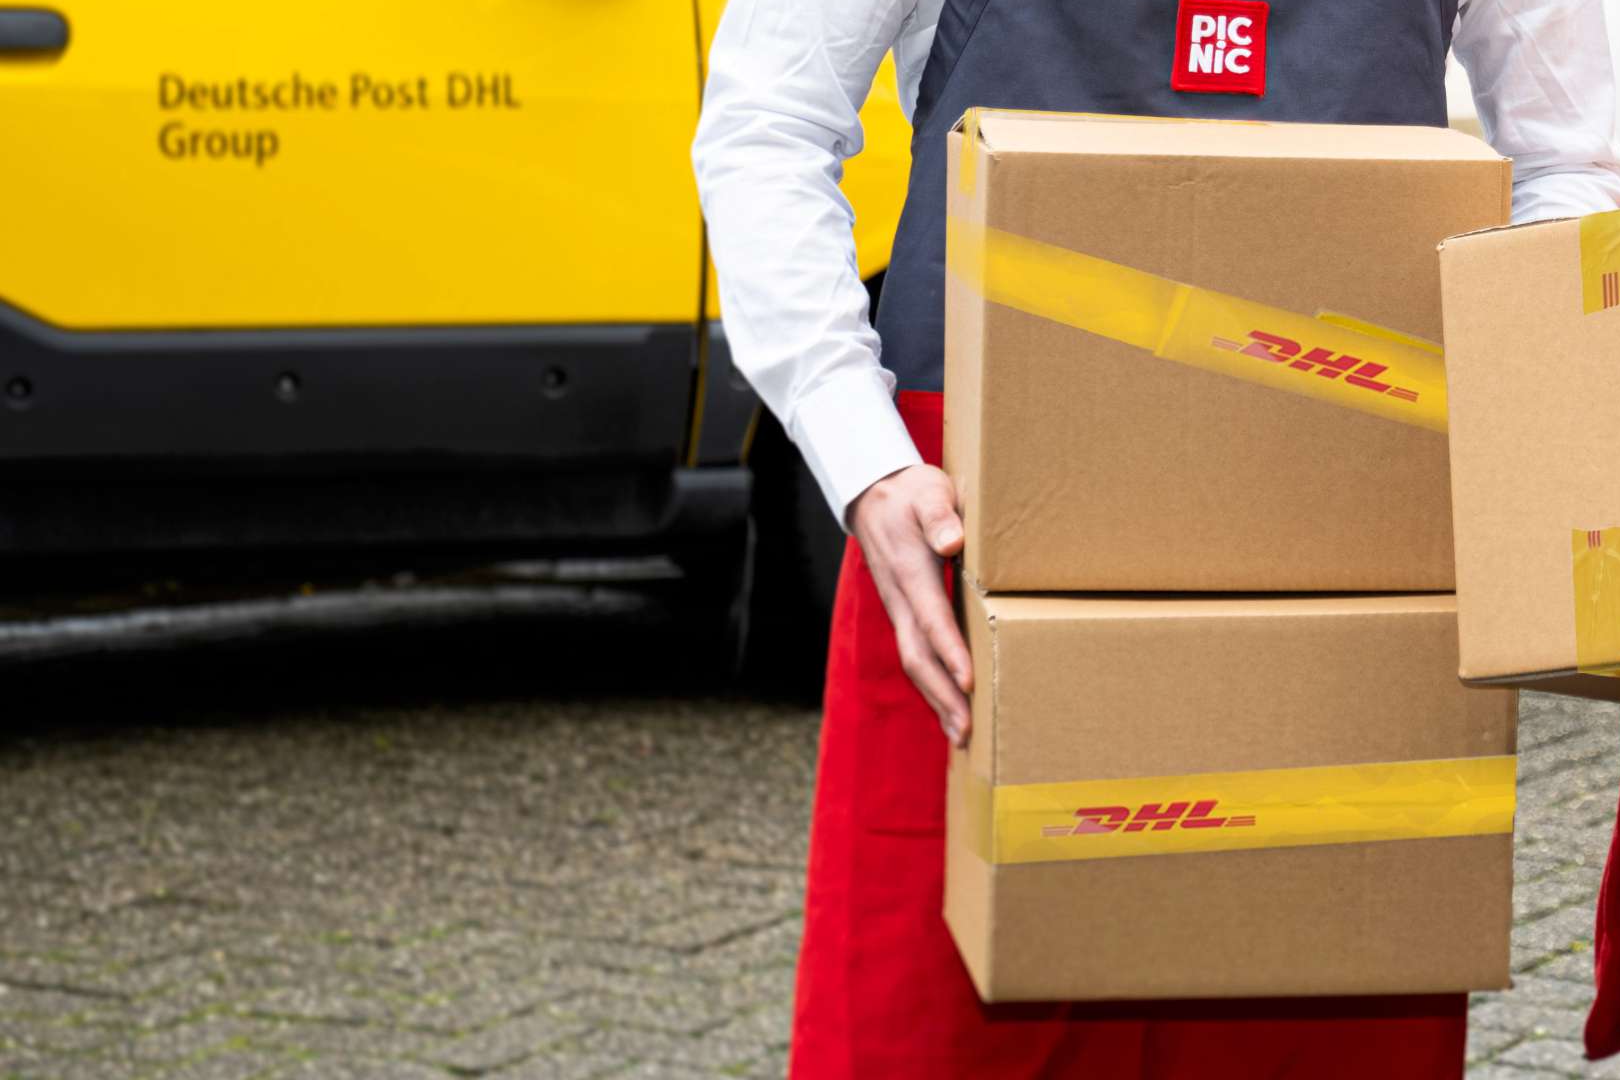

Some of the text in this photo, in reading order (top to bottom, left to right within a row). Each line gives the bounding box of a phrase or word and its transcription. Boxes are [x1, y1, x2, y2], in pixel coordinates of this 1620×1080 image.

[1191, 14, 1253, 46] PIC
[158, 72, 521, 111] Deutsche Post DHL
[158, 121, 280, 167] Group
[1237, 329, 1390, 394] DHL
[1072, 799, 1229, 835] DHL
